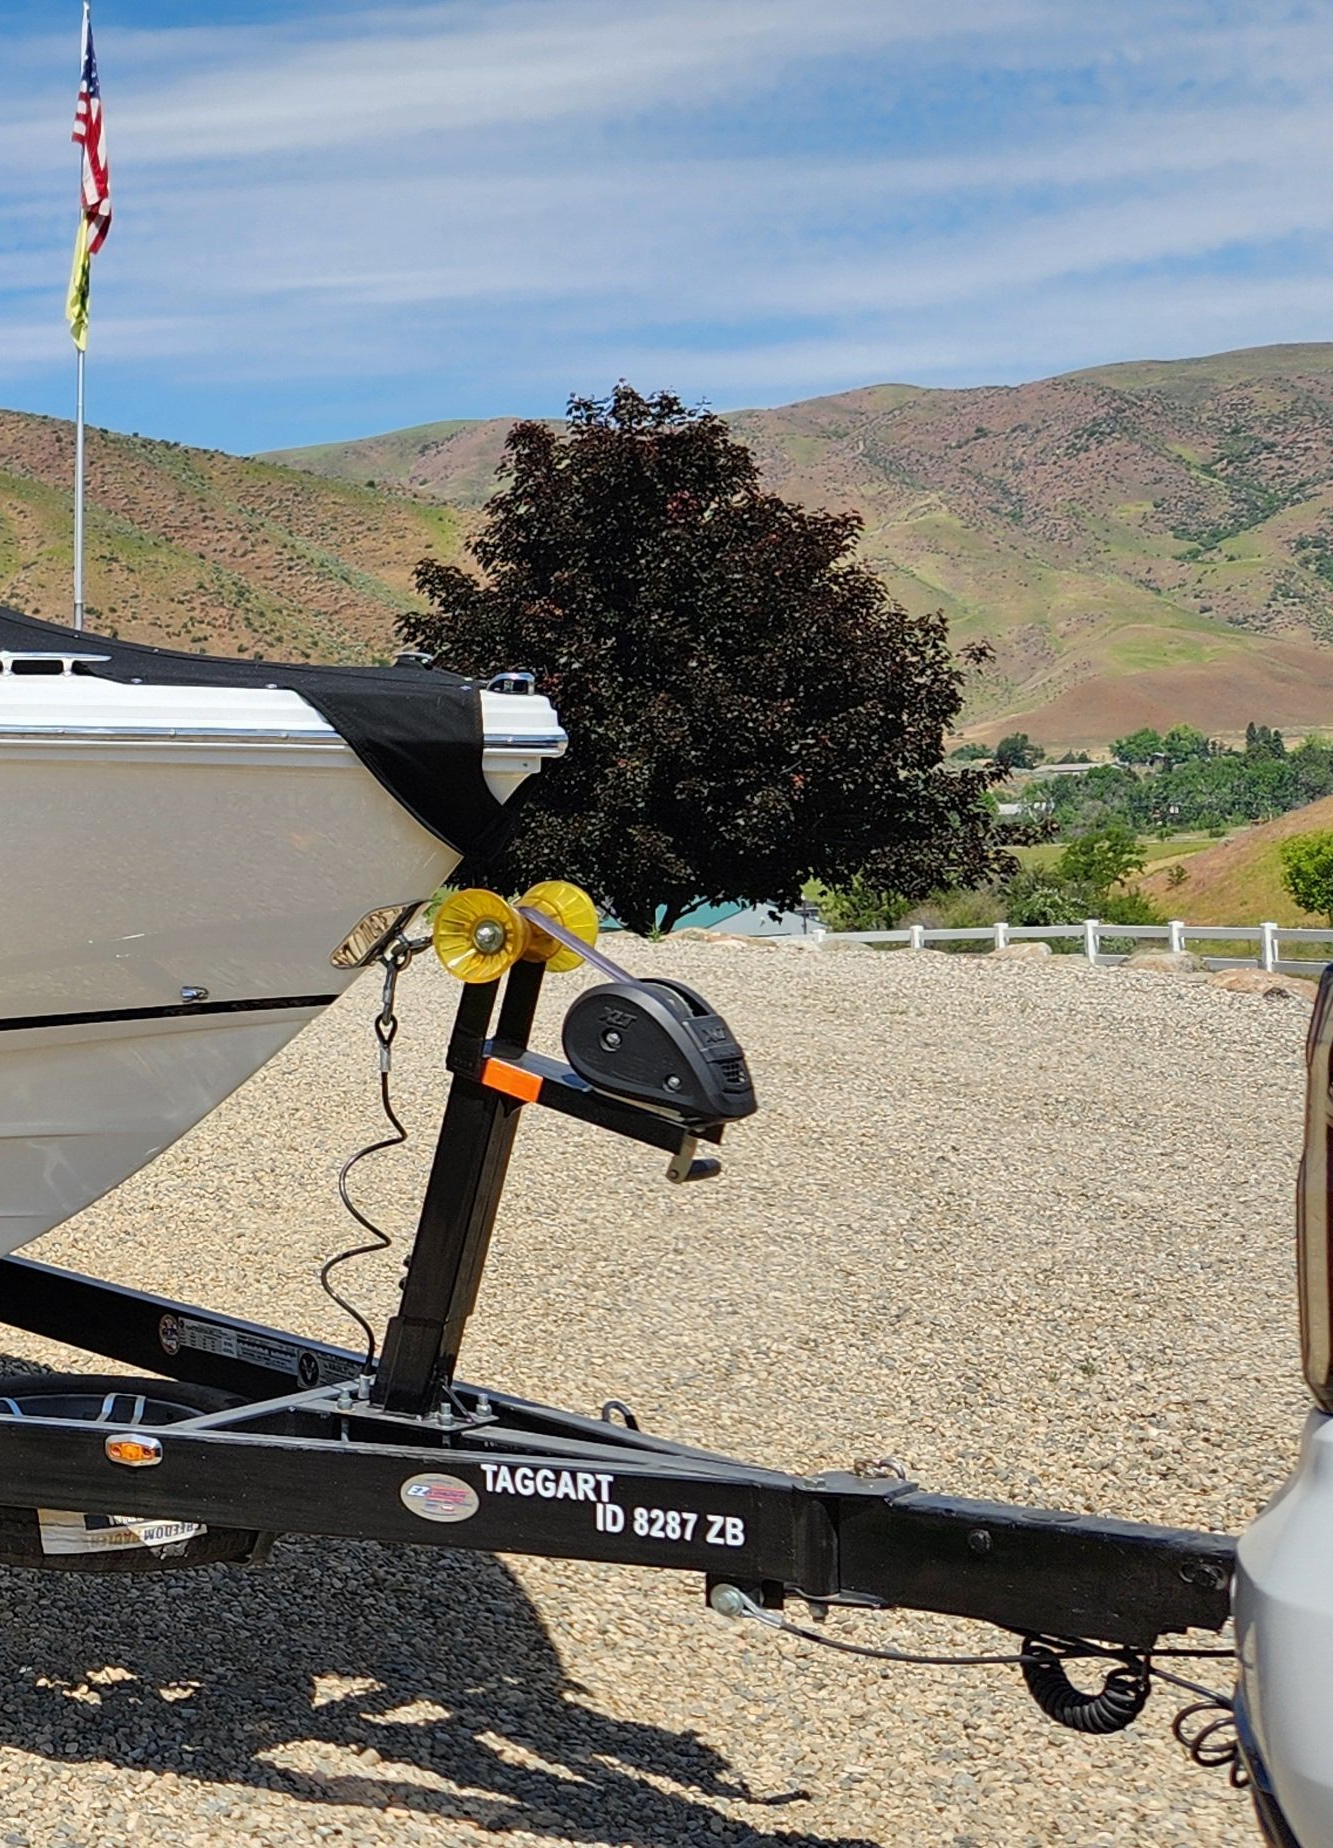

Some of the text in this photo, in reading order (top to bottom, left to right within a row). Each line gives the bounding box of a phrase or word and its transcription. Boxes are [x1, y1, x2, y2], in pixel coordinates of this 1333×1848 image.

[480, 1463, 614, 1503] TAGGART
[595, 1503, 746, 1547] ID 8287 ZB
